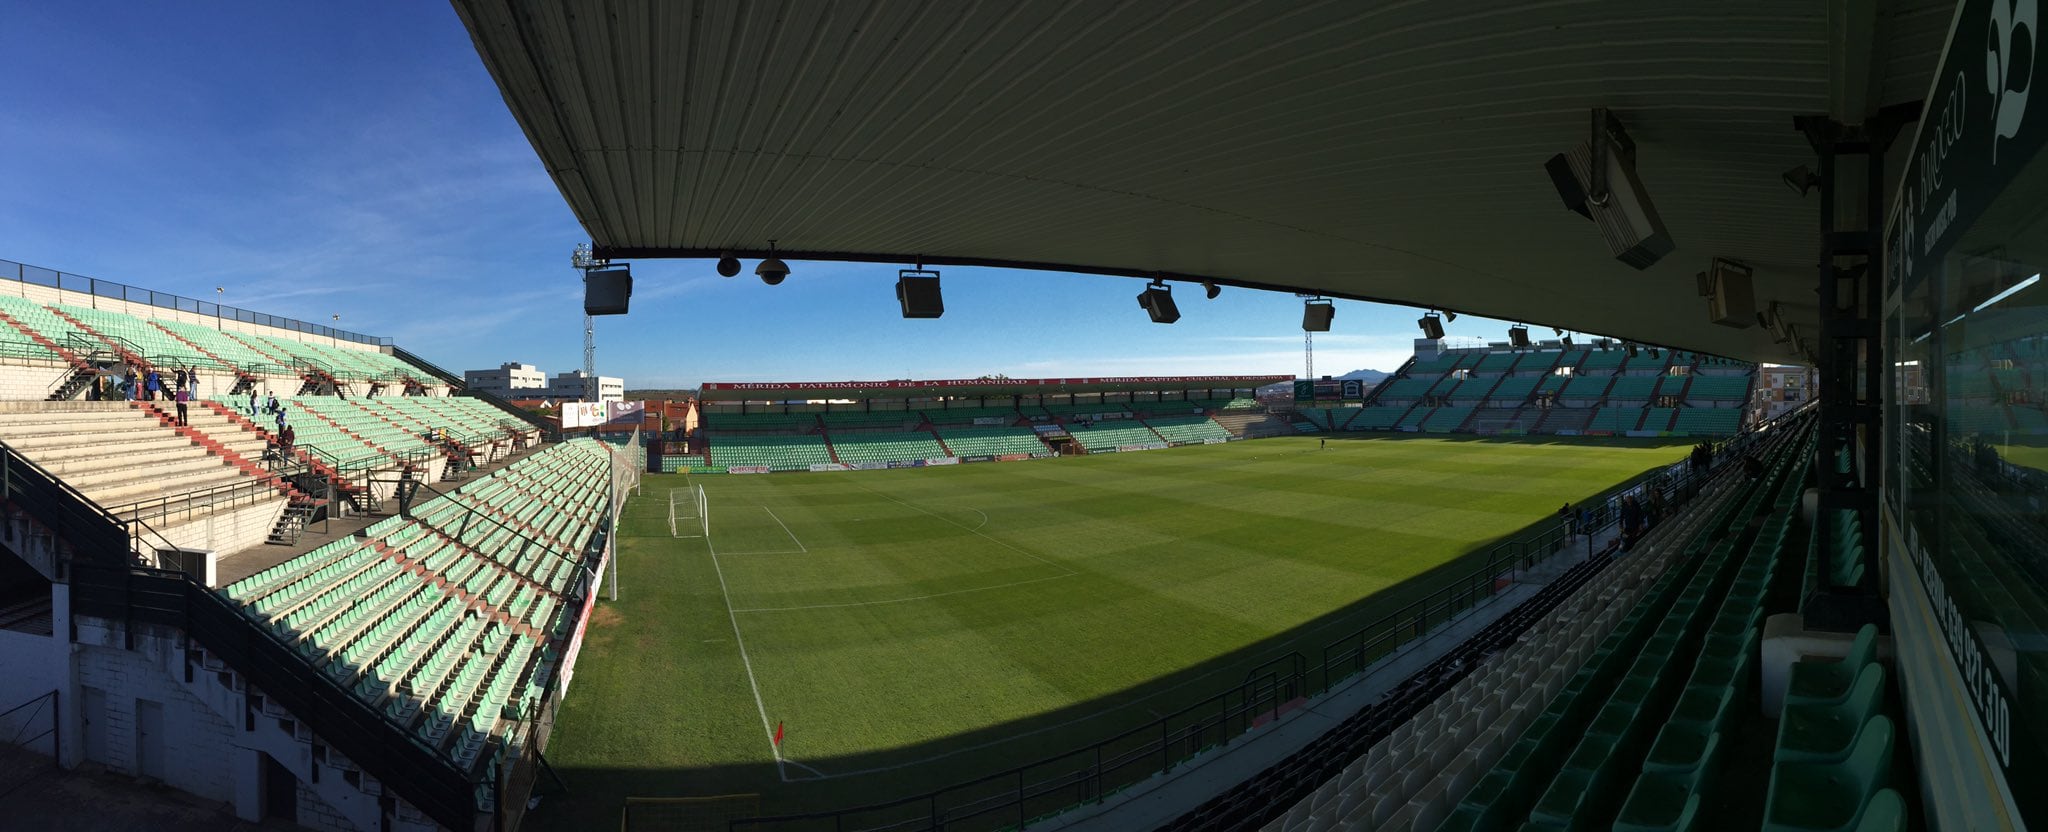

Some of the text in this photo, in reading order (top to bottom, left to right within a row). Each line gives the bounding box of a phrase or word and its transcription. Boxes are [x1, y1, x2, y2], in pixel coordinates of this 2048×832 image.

[1920, 71, 1966, 215] BAROCCO
[799, 381, 889, 389] PATRIMONIO
[1965, 627, 1984, 712] 921
[1985, 667, 2010, 768] 310
